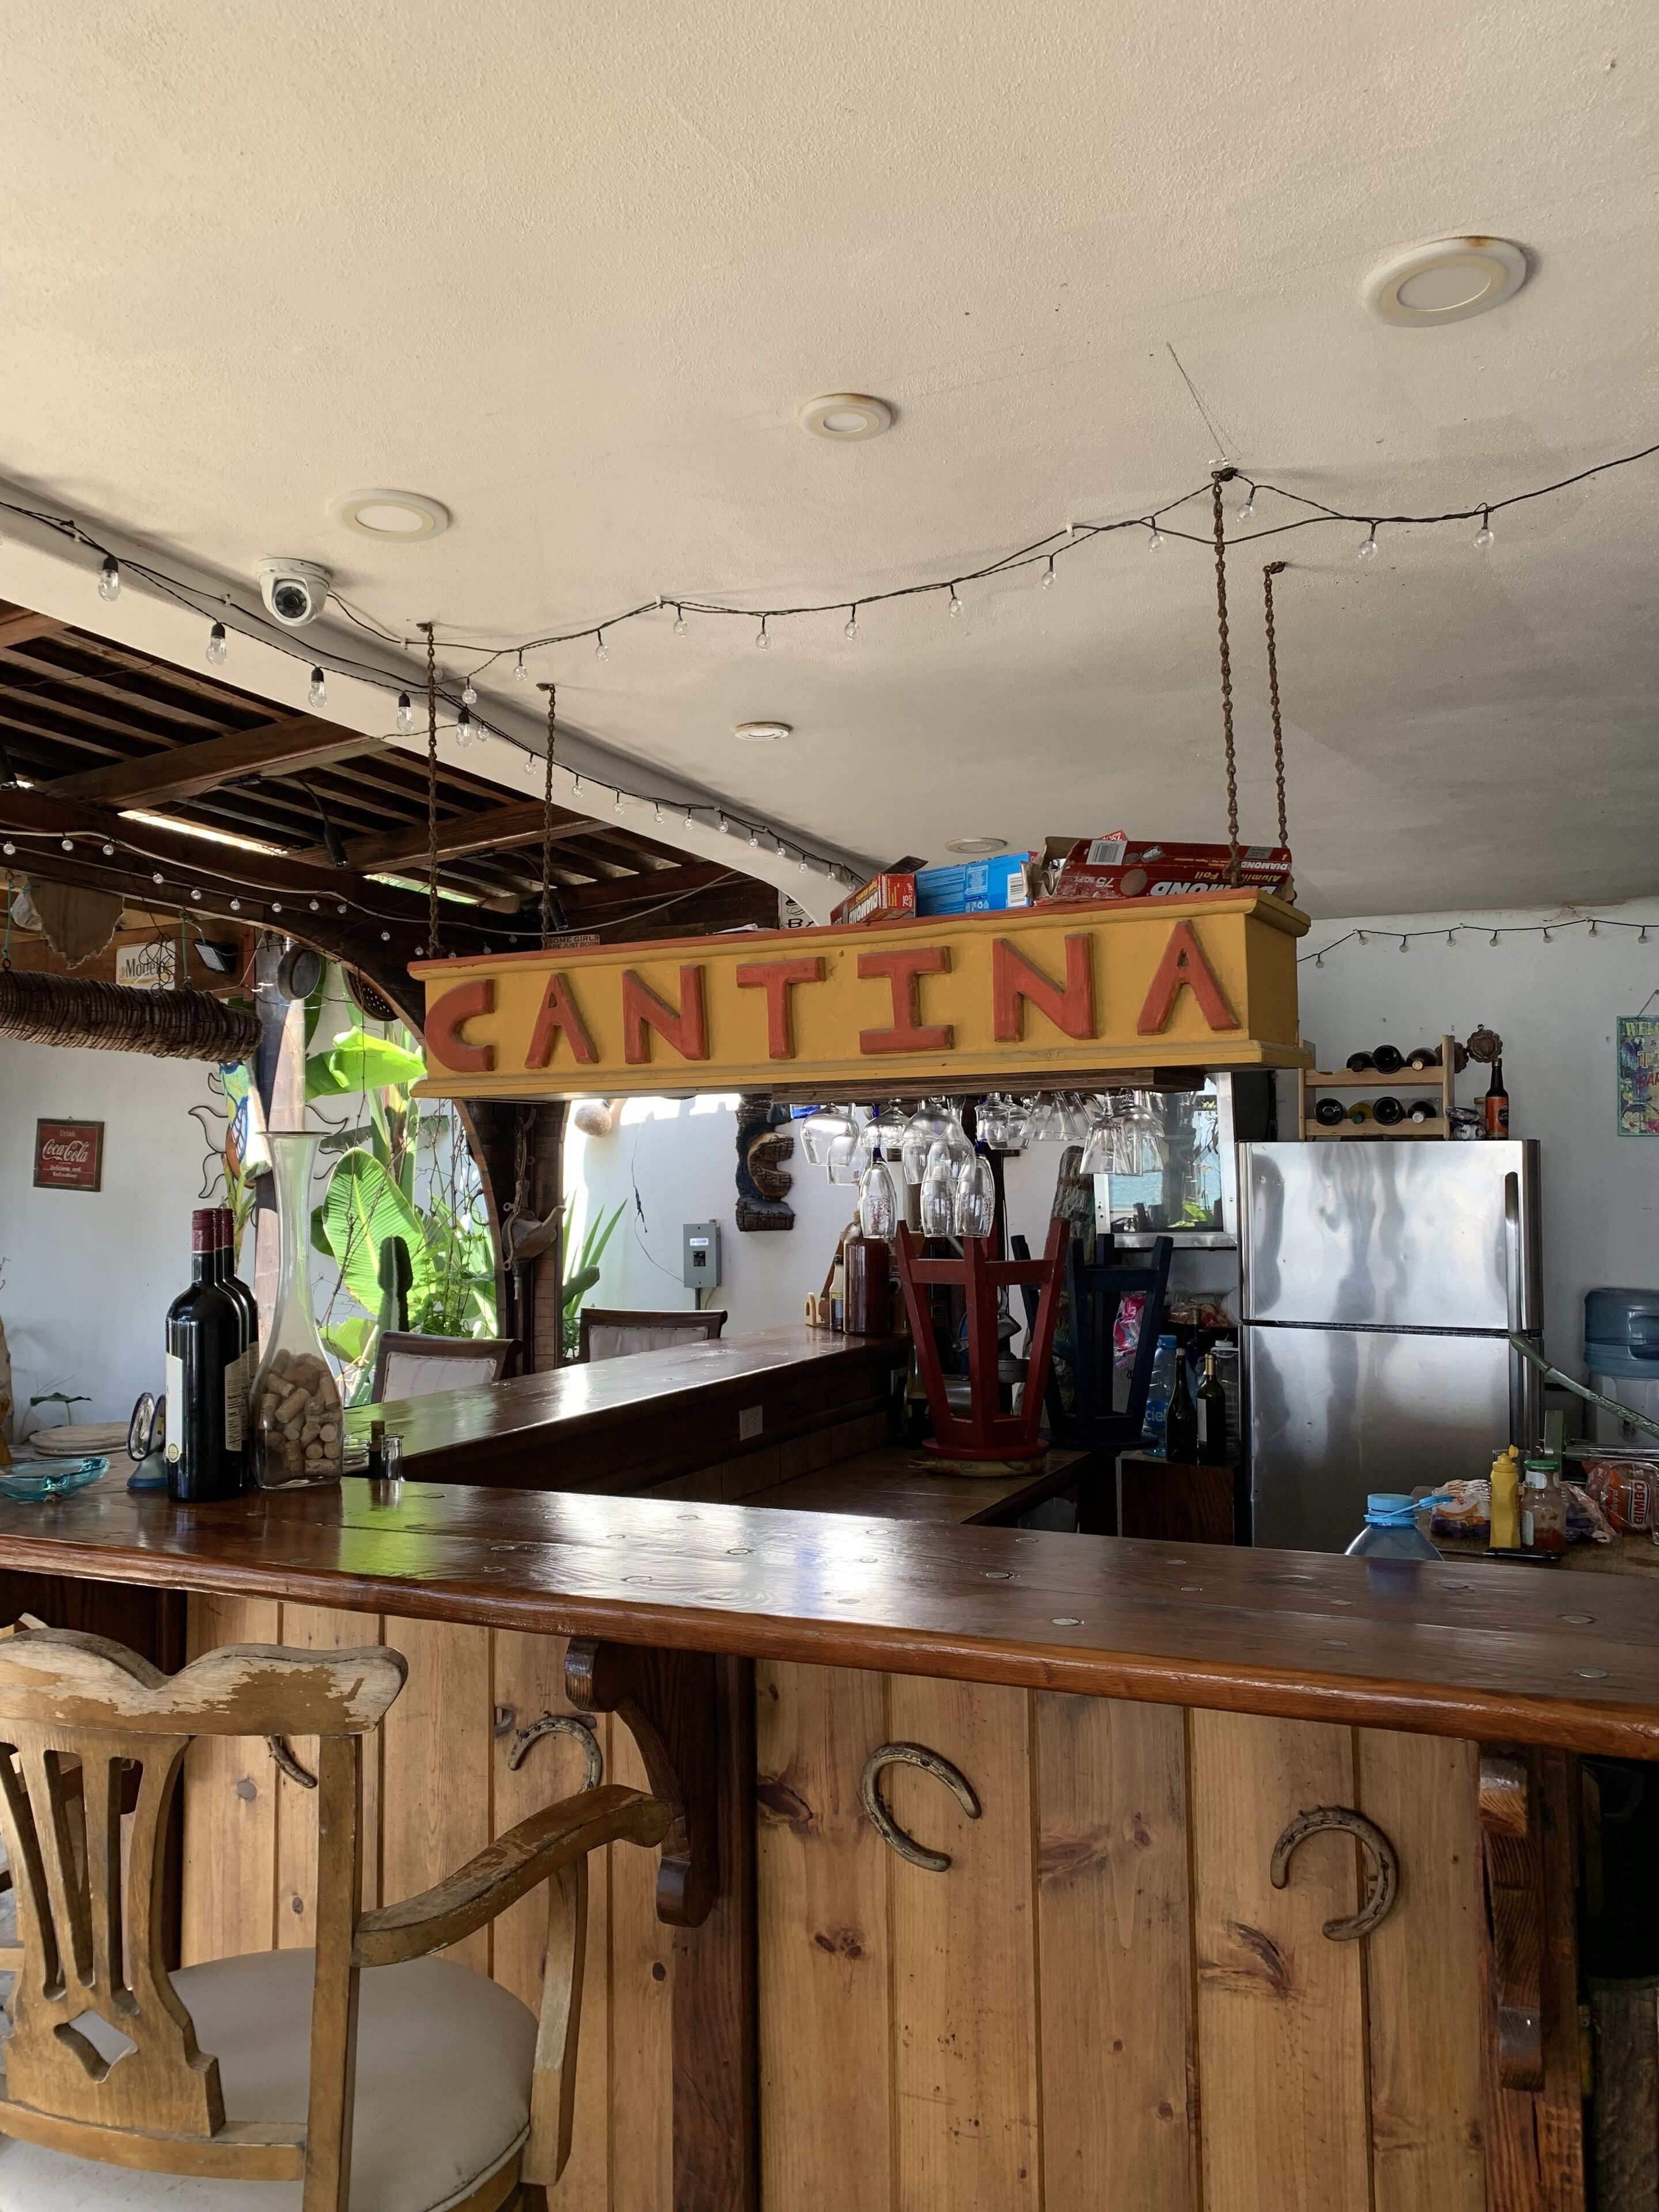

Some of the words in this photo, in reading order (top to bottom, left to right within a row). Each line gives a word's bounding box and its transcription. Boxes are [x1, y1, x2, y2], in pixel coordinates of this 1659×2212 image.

[1241, 861, 1289, 870] DIAMOND
[1194, 871, 1219, 880] Foil
[1095, 877, 1115, 888] 75
[849, 890, 878, 924] DIAMOND
[902, 895, 909, 907] 75
[424, 920, 1241, 1072] CANTINA
[1633, 1482, 1646, 1525] BIMBO
